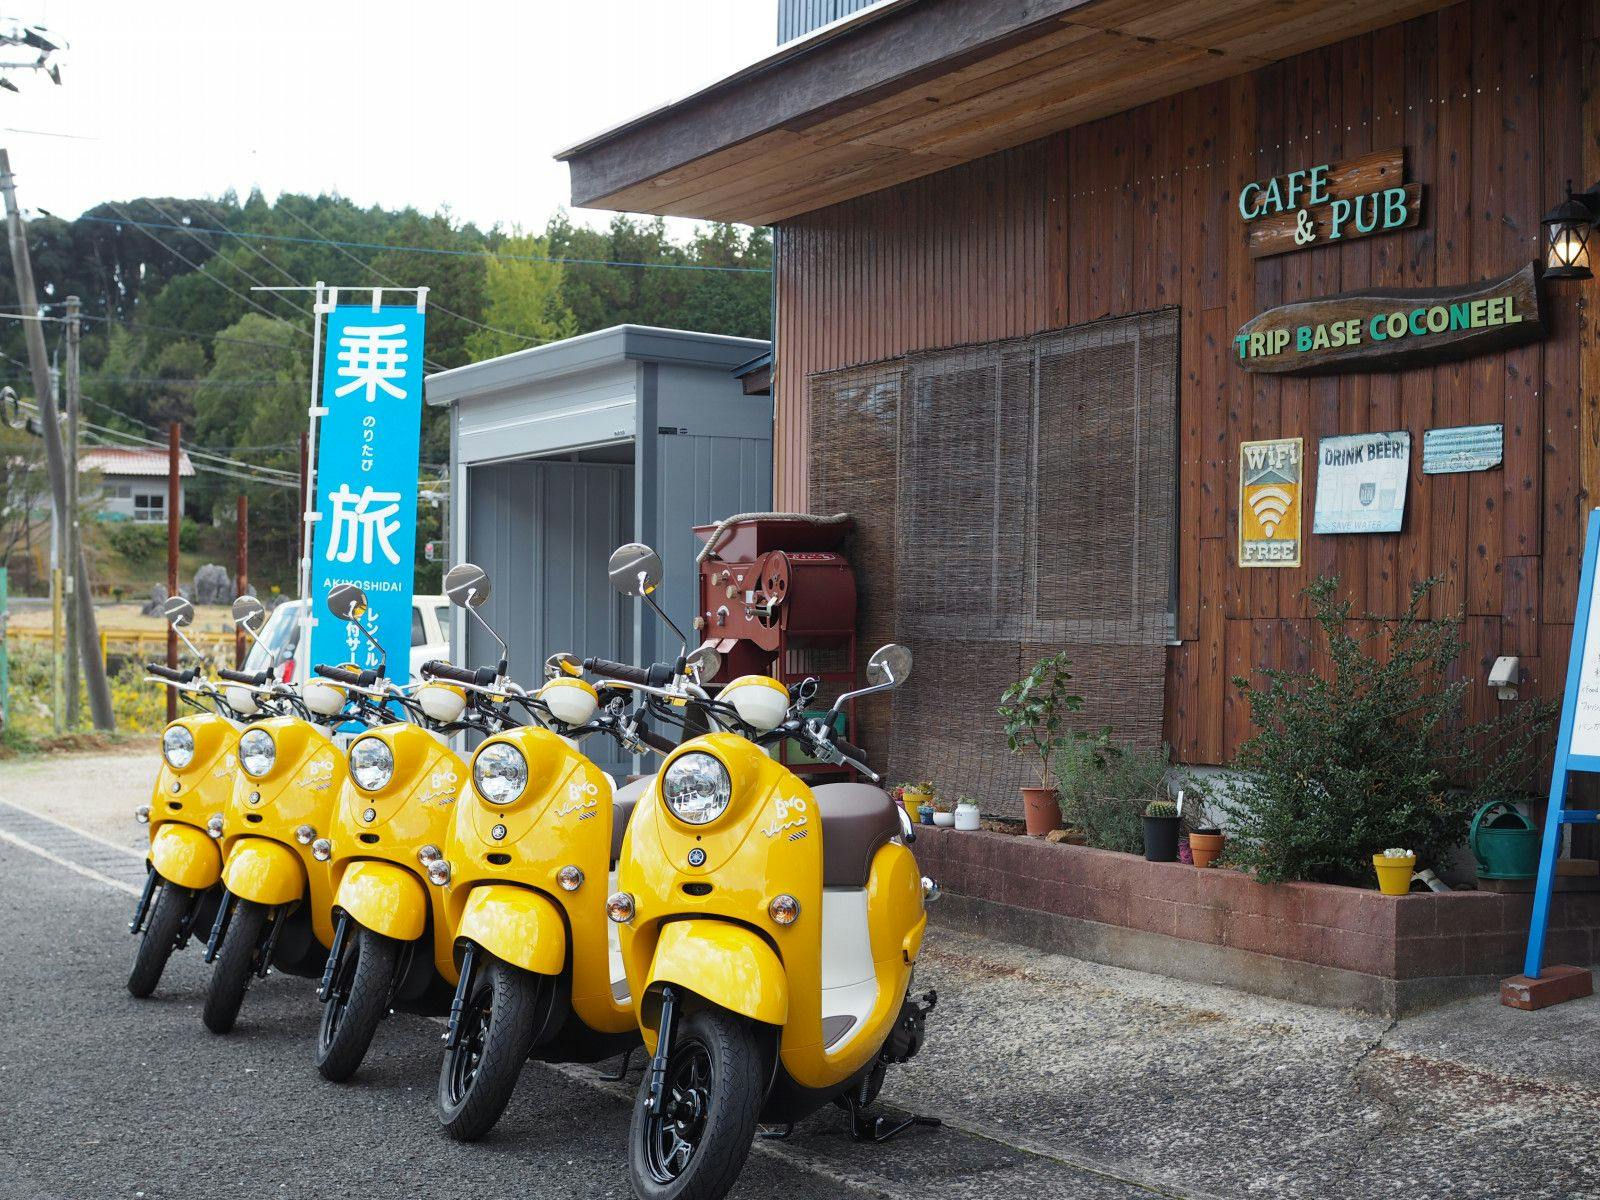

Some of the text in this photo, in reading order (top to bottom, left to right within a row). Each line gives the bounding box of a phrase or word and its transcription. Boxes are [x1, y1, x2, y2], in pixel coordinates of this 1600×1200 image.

[1238, 164, 1330, 220] CAFE
[1294, 187, 1408, 246] & PUB
[1235, 296, 1522, 359] TRIP BASE COCONEEL
[335, 323, 409, 403] 乗
[361, 415, 376, 472] のりたび
[1324, 440, 1405, 467] DRINK BEER!
[326, 483, 401, 565] 旅
[1244, 543, 1295, 560] FREE
[1354, 520, 1383, 530] WATER
